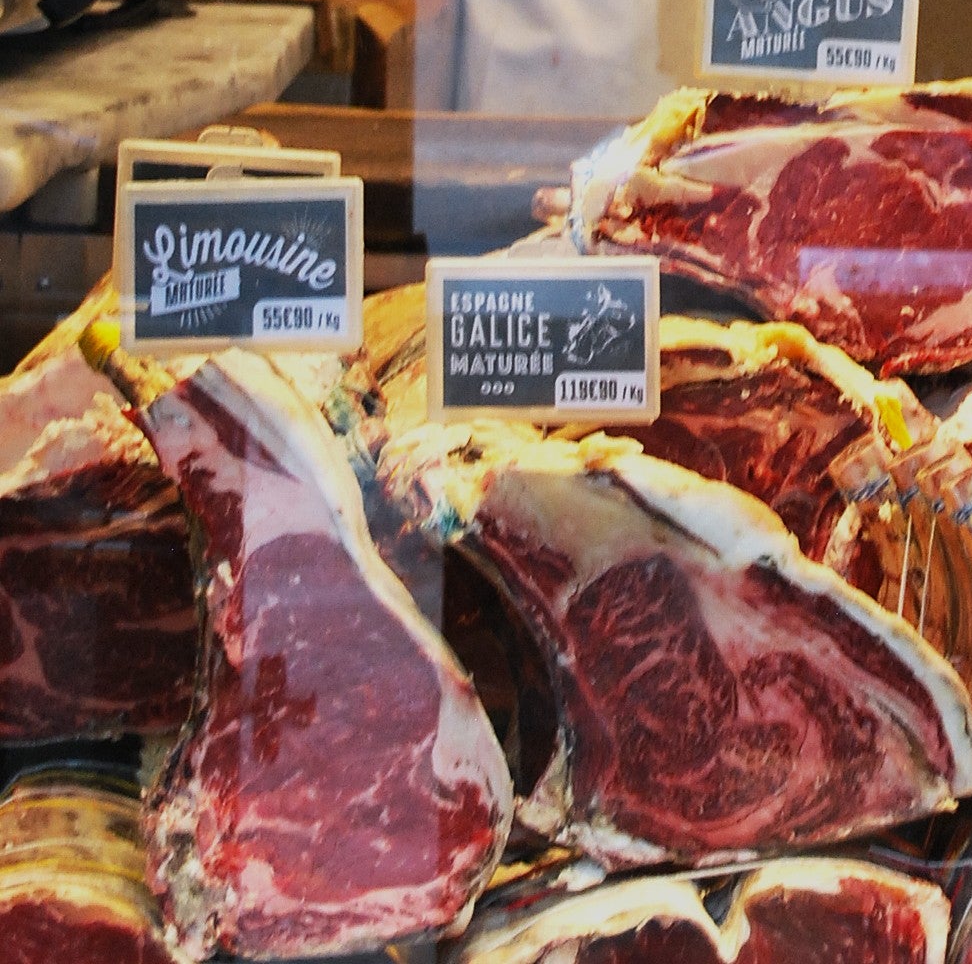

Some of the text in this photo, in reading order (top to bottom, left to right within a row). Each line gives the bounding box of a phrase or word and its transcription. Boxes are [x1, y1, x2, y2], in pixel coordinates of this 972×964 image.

[144, 223, 337, 291] Limousine
[451, 291, 535, 313] ESPAGNE
[451, 312, 551, 348] GALICE
[450, 349, 553, 375] MATURÉE
